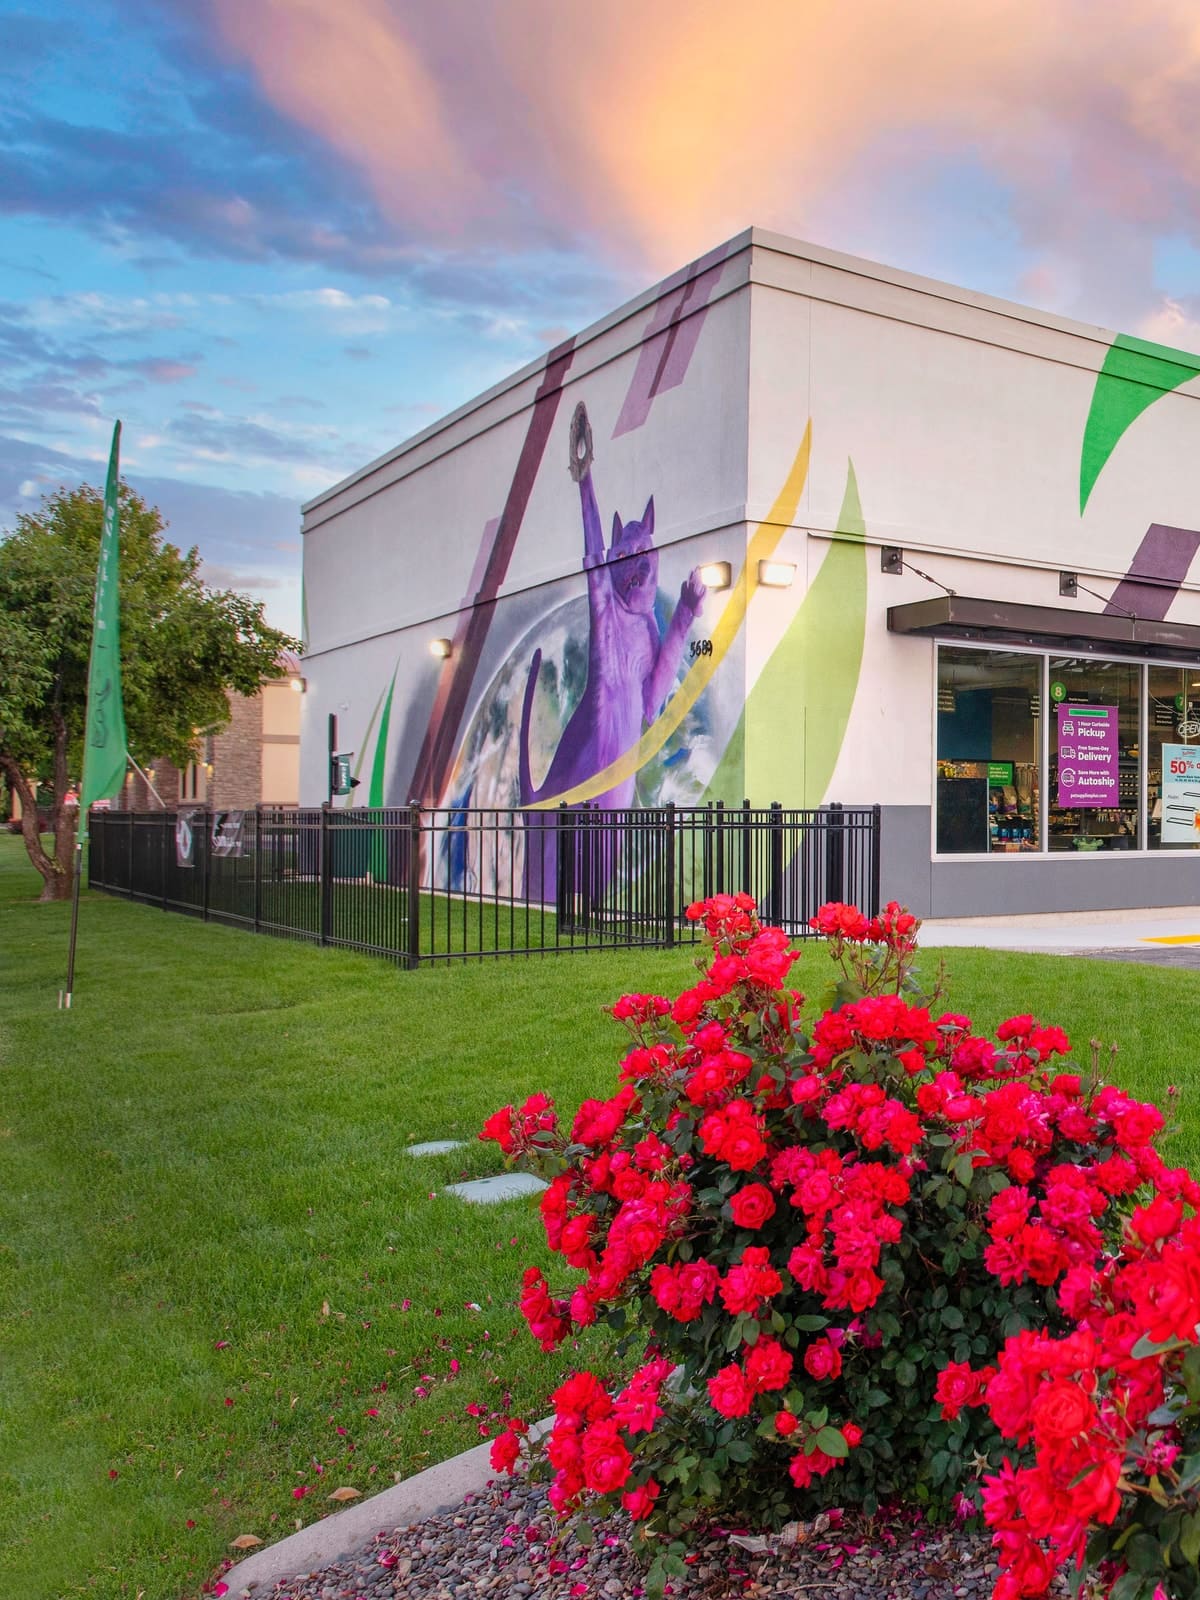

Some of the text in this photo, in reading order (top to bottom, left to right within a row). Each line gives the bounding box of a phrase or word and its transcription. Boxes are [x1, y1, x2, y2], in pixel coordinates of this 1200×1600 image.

[690, 639, 713, 658] 5689
[1055, 686, 1063, 697] 8
[1078, 728, 1105, 739] Pickup
[1179, 723, 1200, 734] OPEN
[1078, 752, 1111, 763] Delivery
[1078, 777, 1115, 787] Autoship
